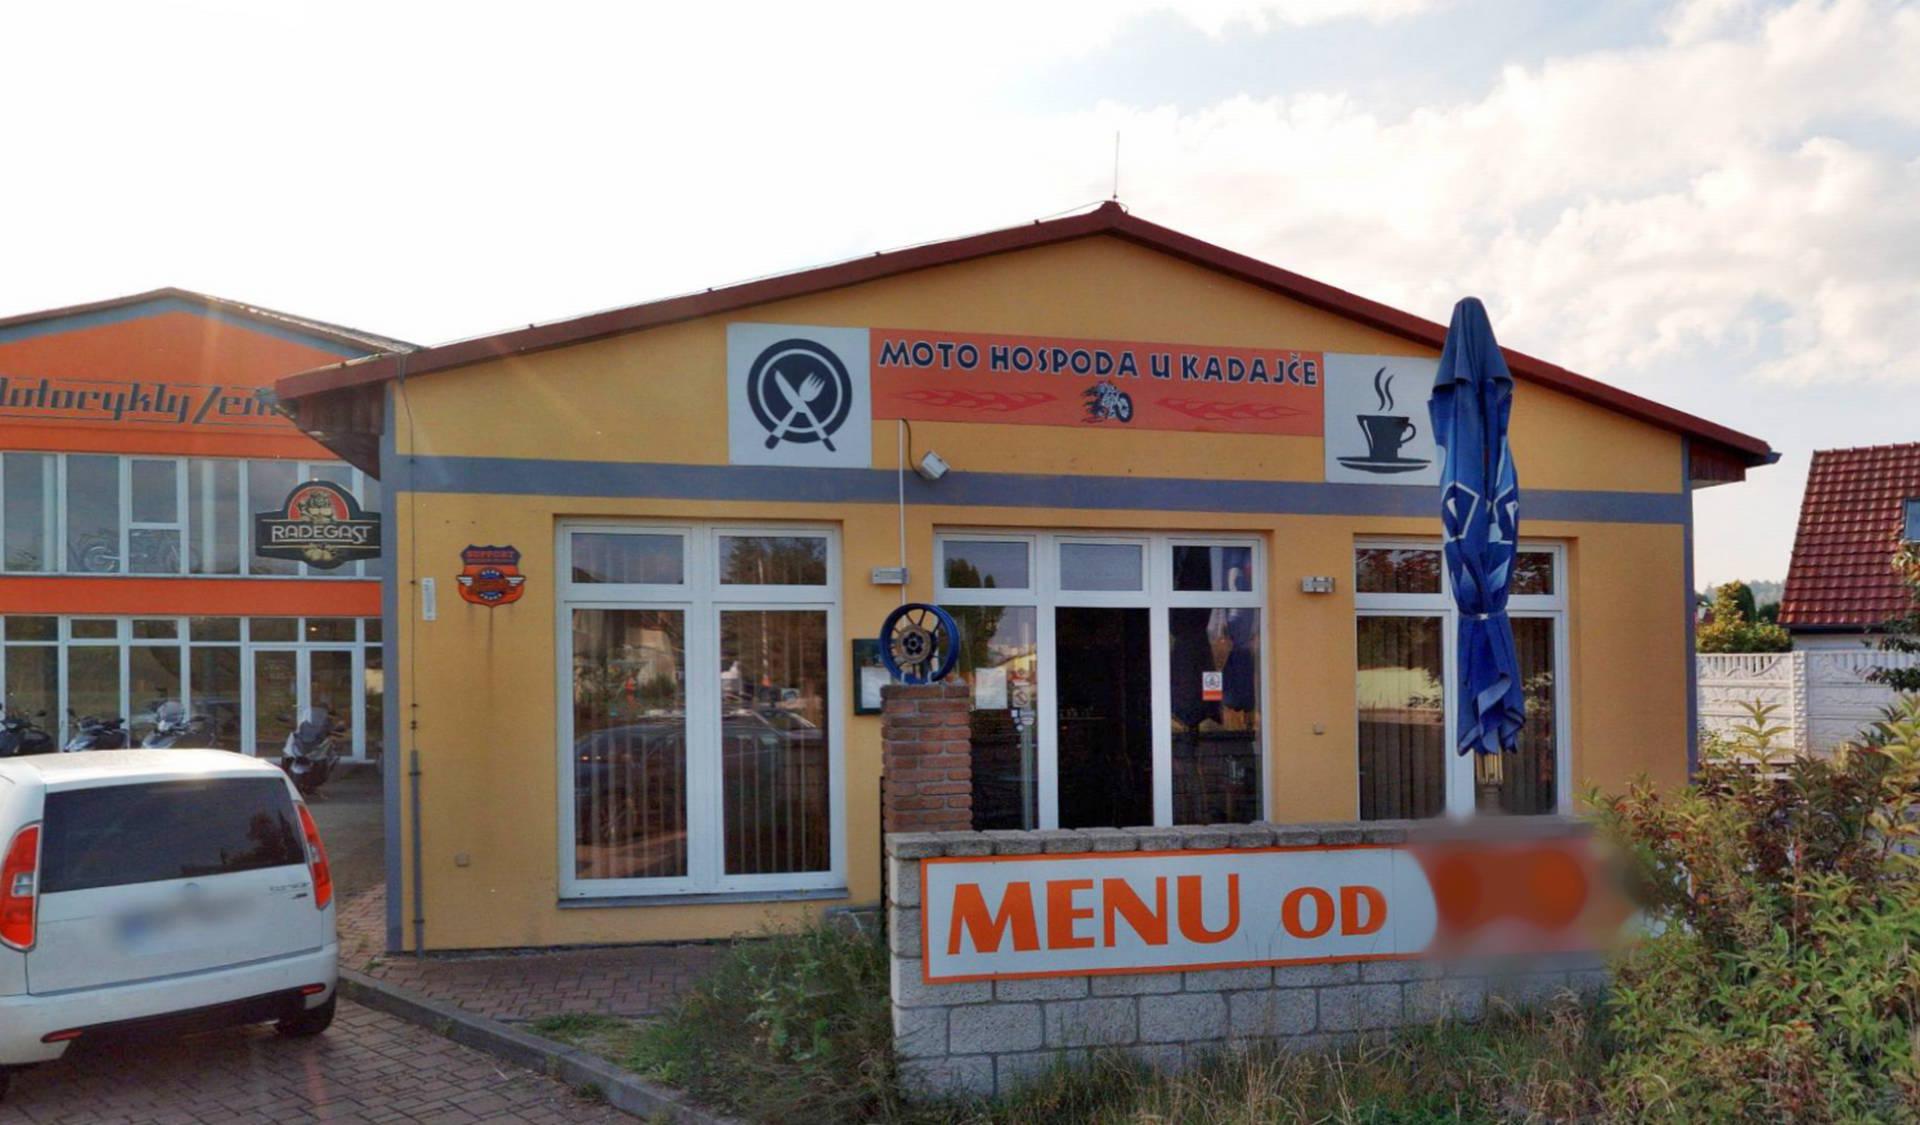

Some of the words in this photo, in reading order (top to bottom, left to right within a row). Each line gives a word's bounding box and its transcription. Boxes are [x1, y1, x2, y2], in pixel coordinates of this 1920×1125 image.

[878, 340, 980, 370] MOTO
[989, 345, 1138, 377] HOSPODA
[1150, 353, 1171, 379] U
[1181, 352, 1318, 386] KADAJČE
[271, 524, 373, 545] RADEGAST
[946, 872, 1241, 956] MENU
[1280, 884, 1388, 939] OD
